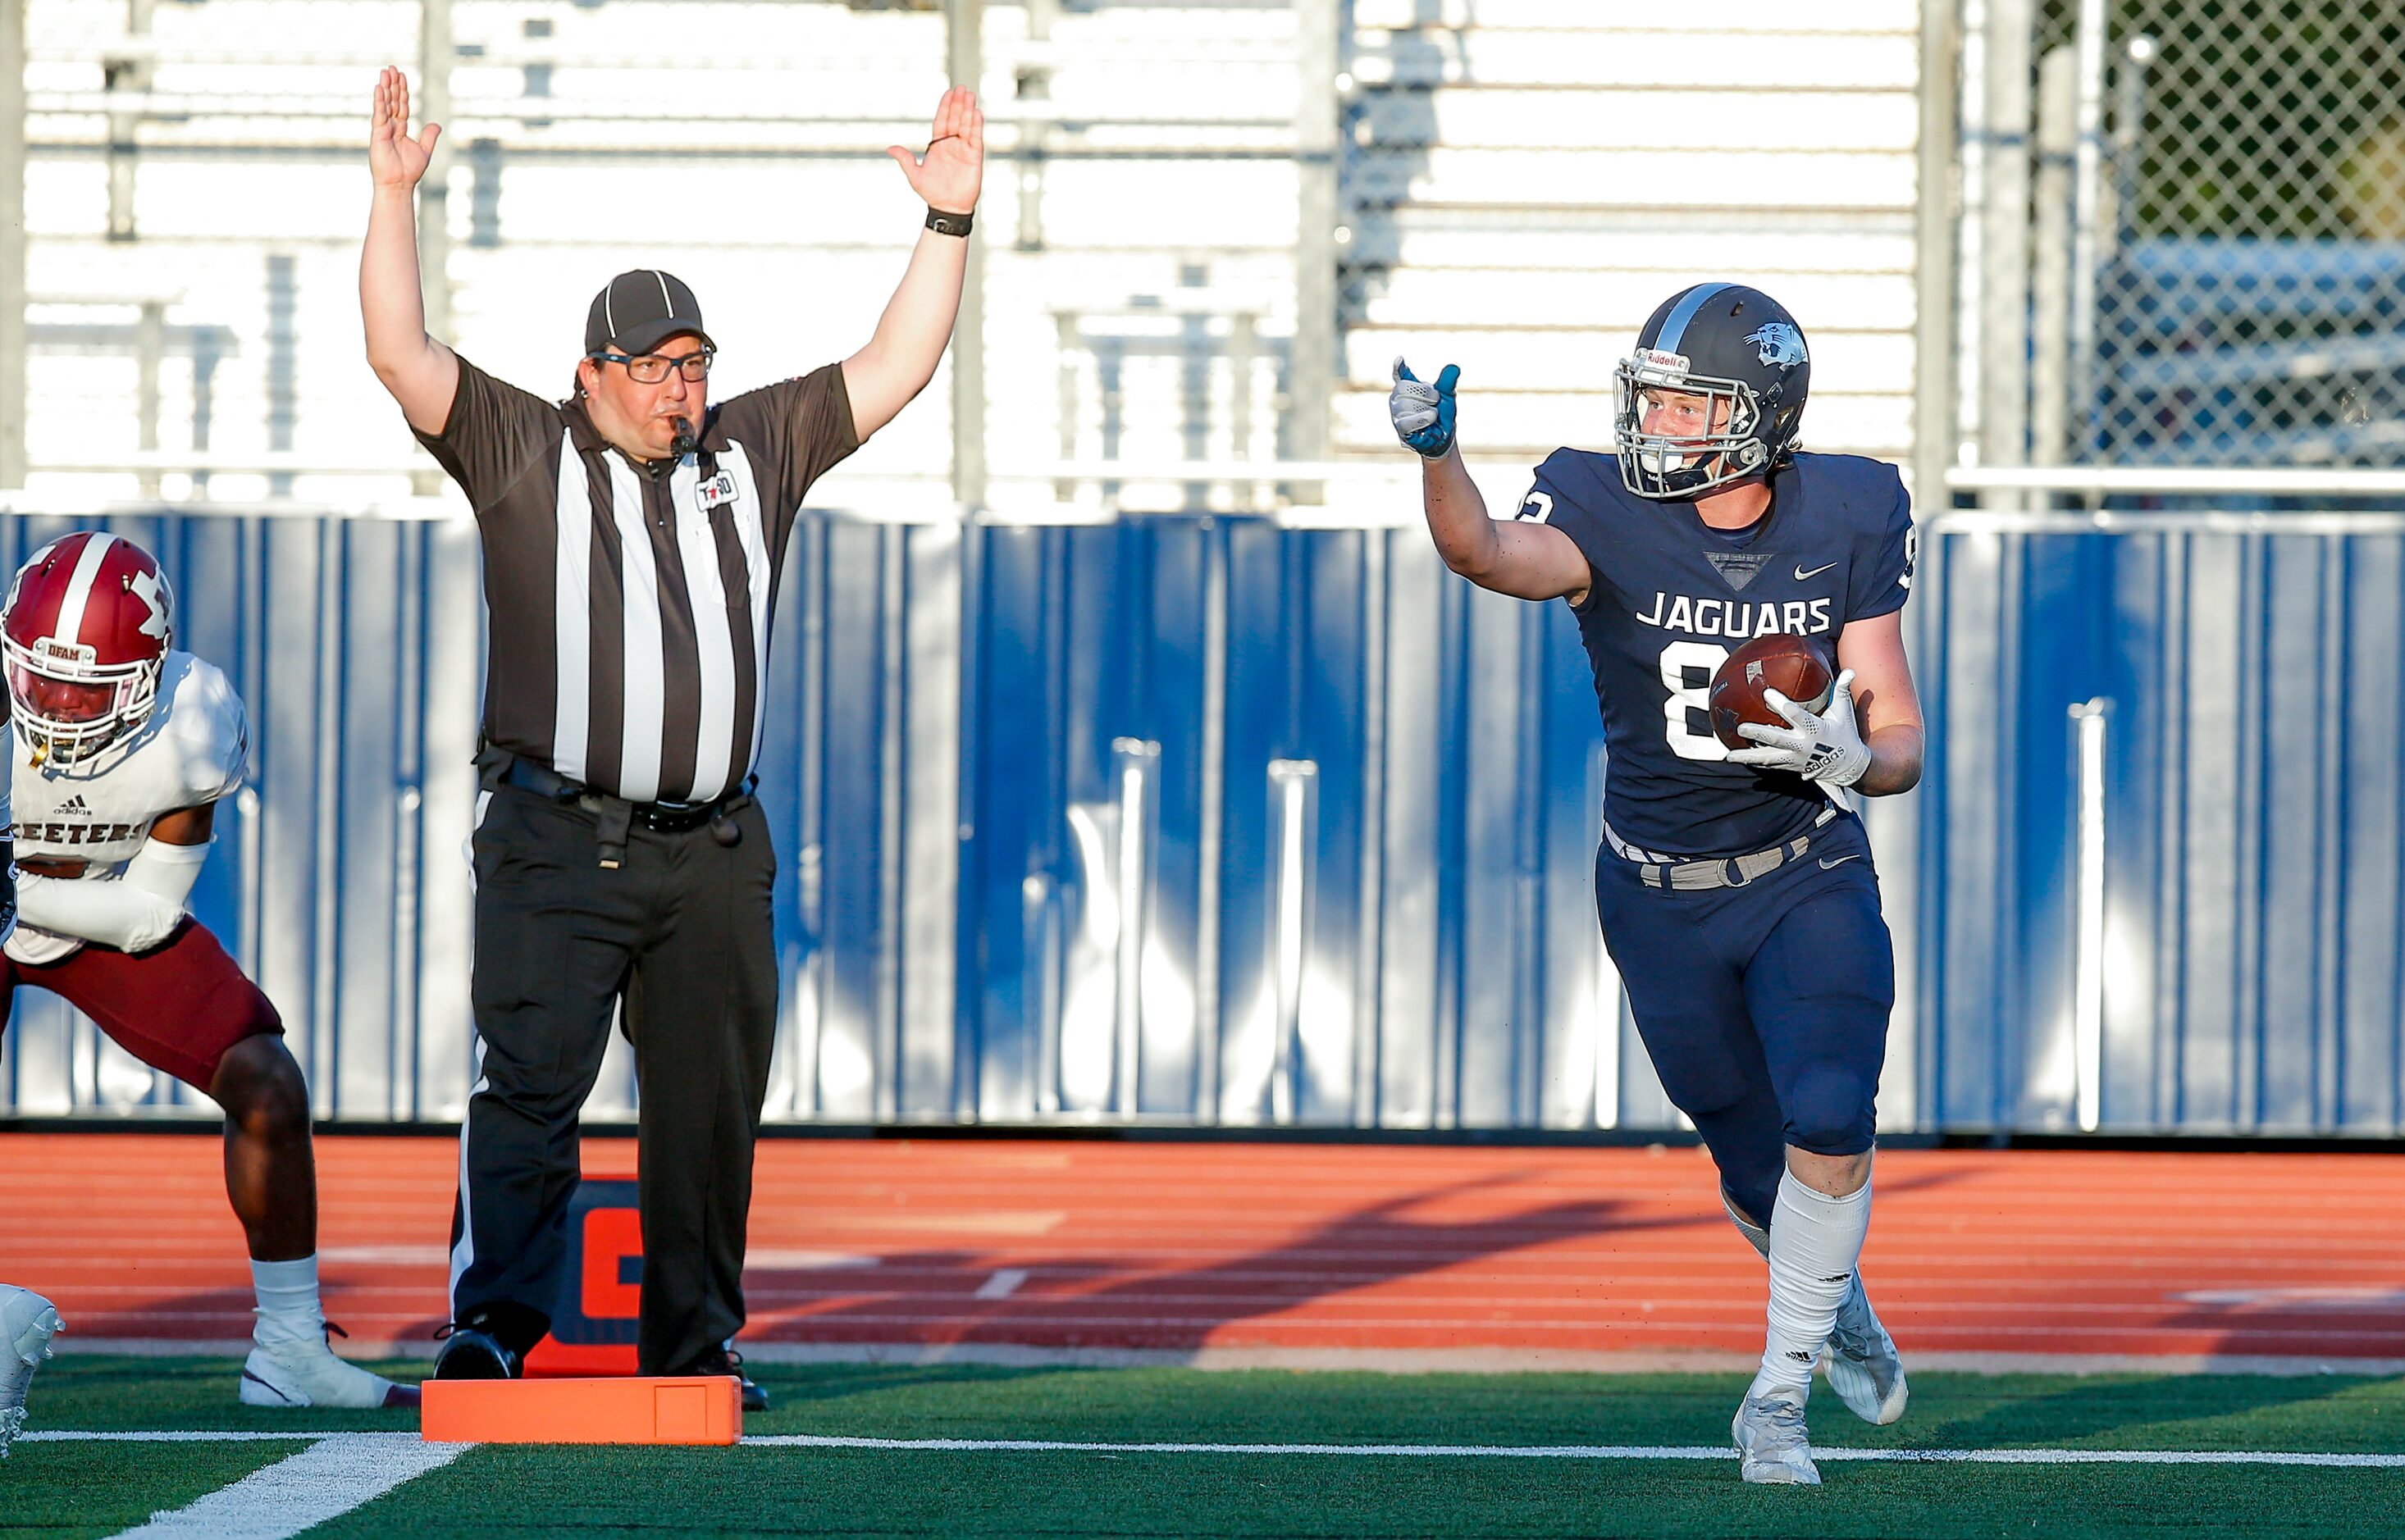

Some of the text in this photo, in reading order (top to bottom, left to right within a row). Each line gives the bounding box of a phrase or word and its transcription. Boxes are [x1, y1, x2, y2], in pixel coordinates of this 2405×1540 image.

[1647, 353, 1677, 367] Riddell
[1636, 591, 1831, 639] JAGUARS
[1805, 745, 1846, 774] adidas
